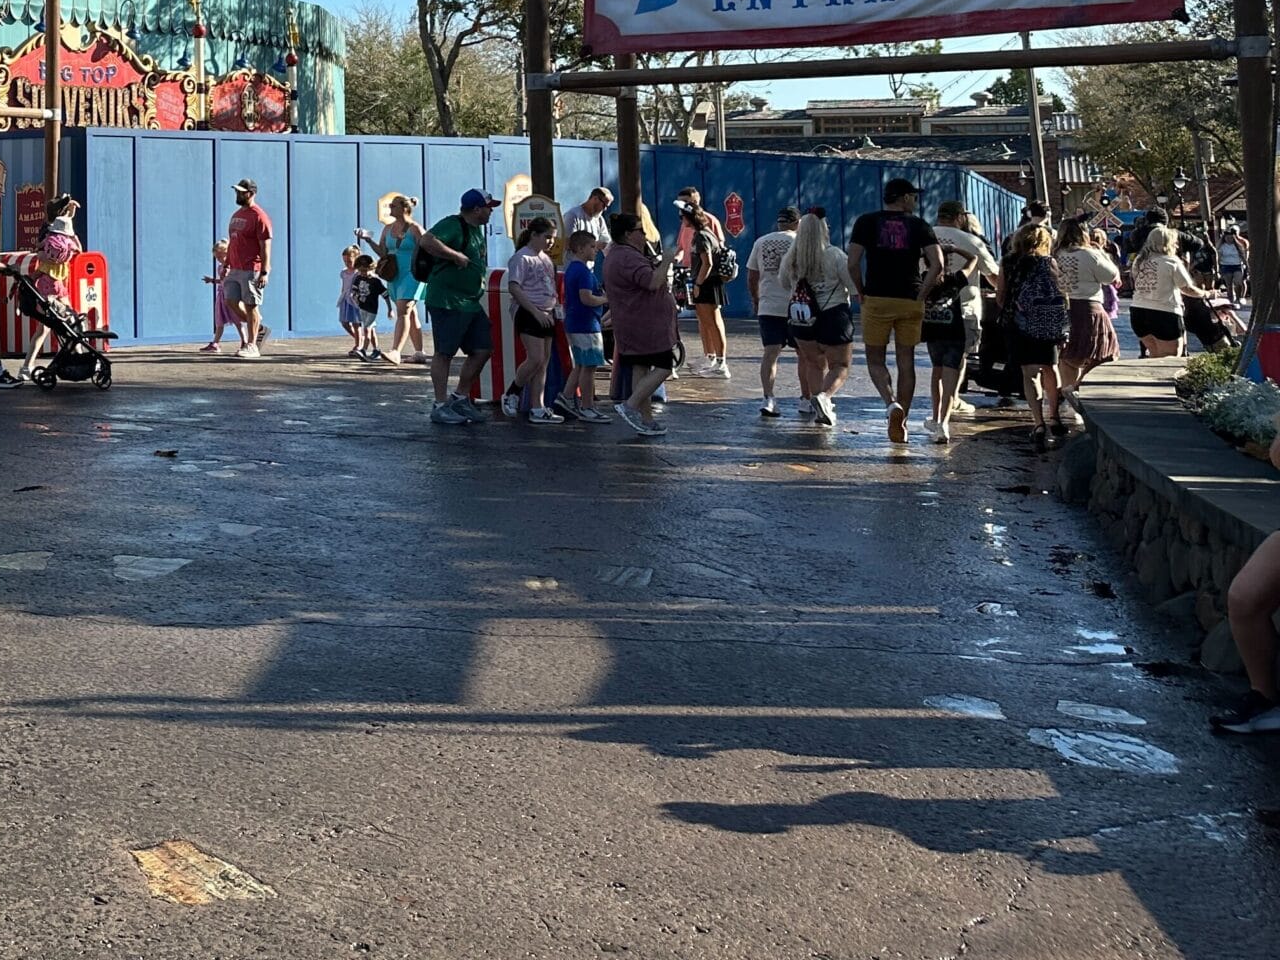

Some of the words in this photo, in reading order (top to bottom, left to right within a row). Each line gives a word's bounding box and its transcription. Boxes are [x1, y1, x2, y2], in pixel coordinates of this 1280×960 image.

[38, 59, 74, 82] BG
[79, 65, 119, 84] TOP
[16, 76, 148, 130] SOVENIRS
[30, 200, 41, 208] AN
